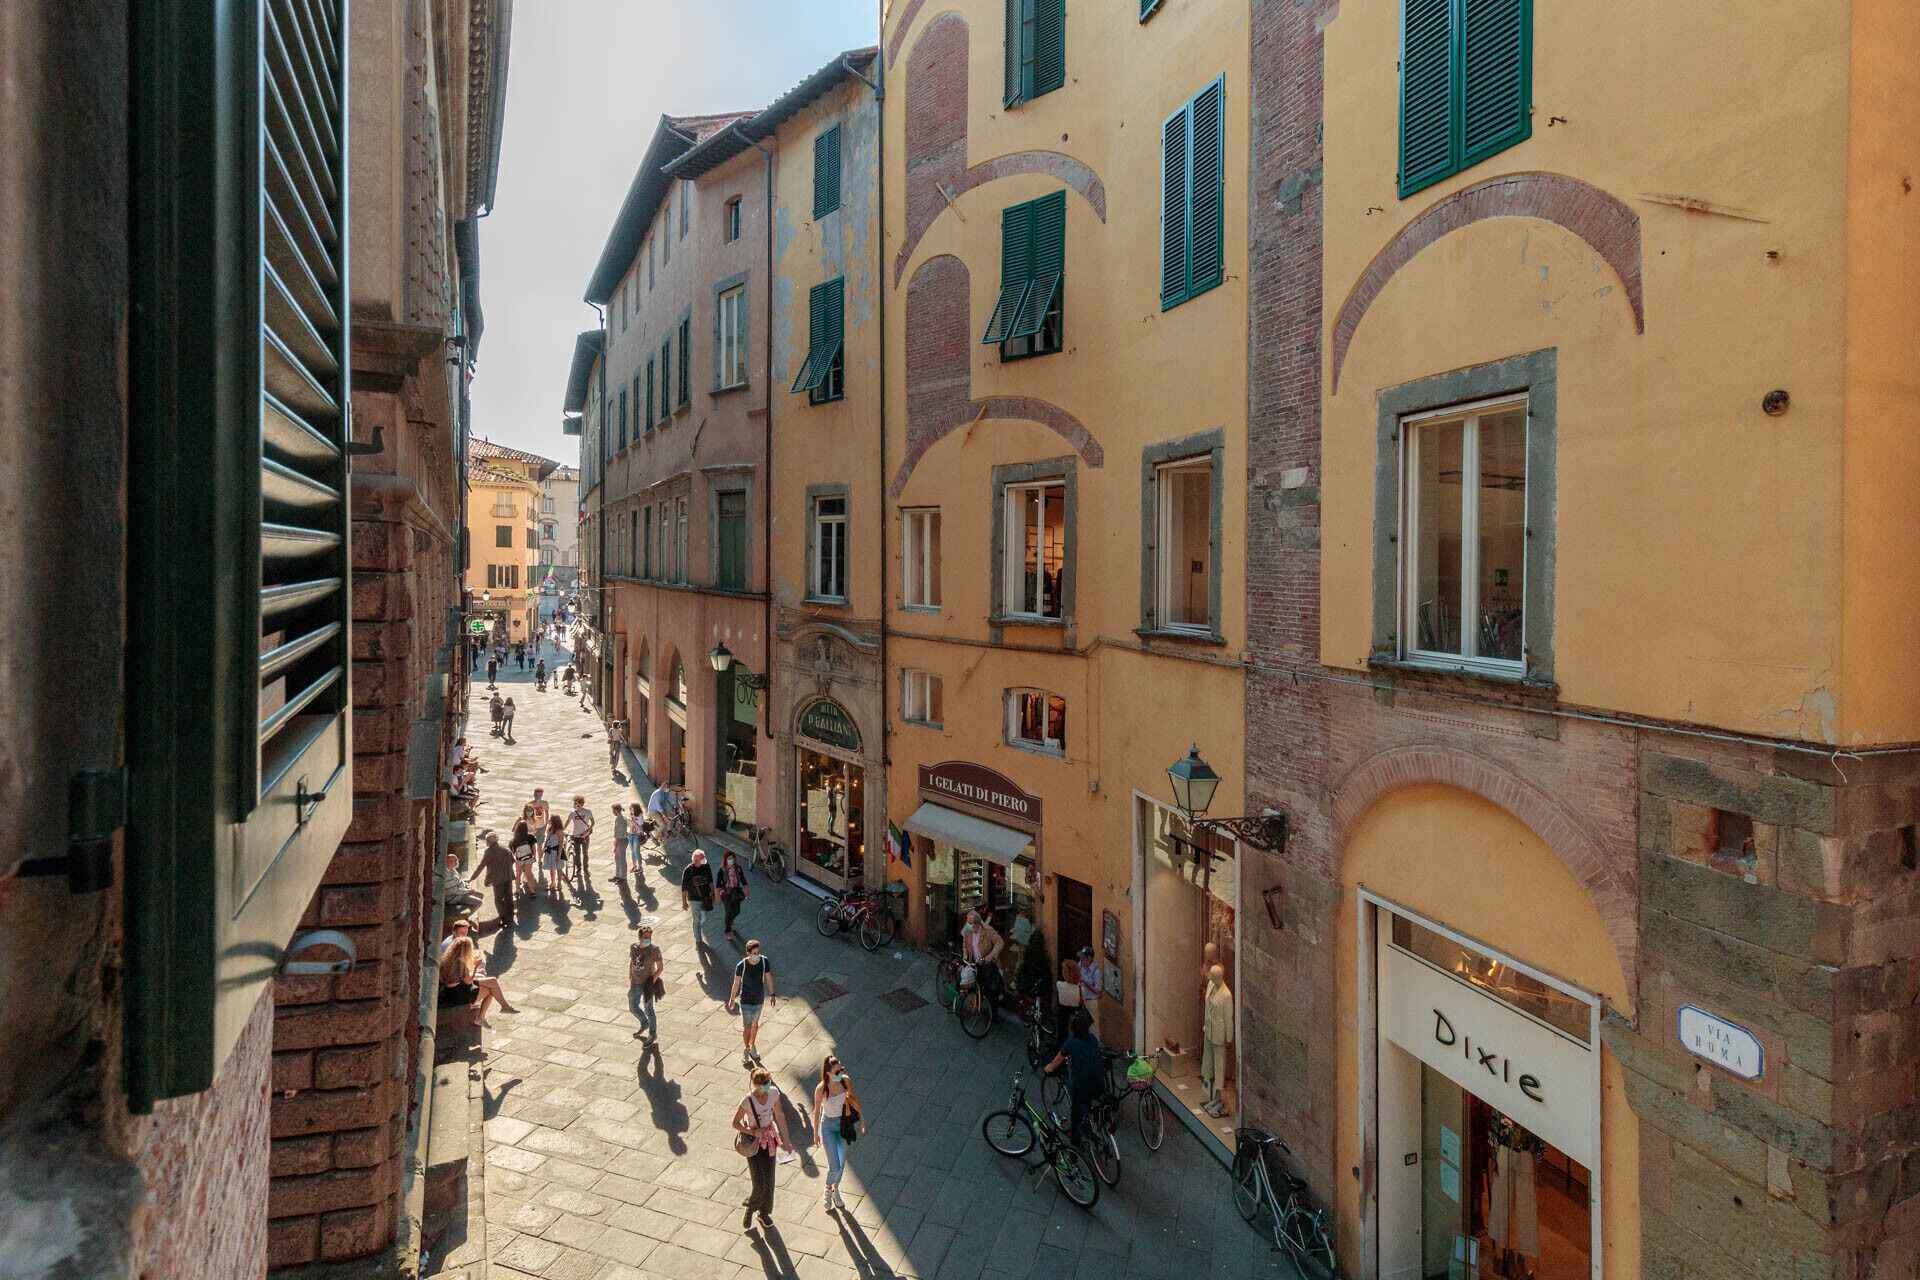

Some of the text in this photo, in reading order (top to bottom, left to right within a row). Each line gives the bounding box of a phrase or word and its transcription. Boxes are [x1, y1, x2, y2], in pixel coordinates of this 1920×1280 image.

[929, 774, 1028, 813] I GELATI DI PIERO
[1695, 1035, 1742, 1067] ROMA
[1707, 1025, 1730, 1045] VIA
